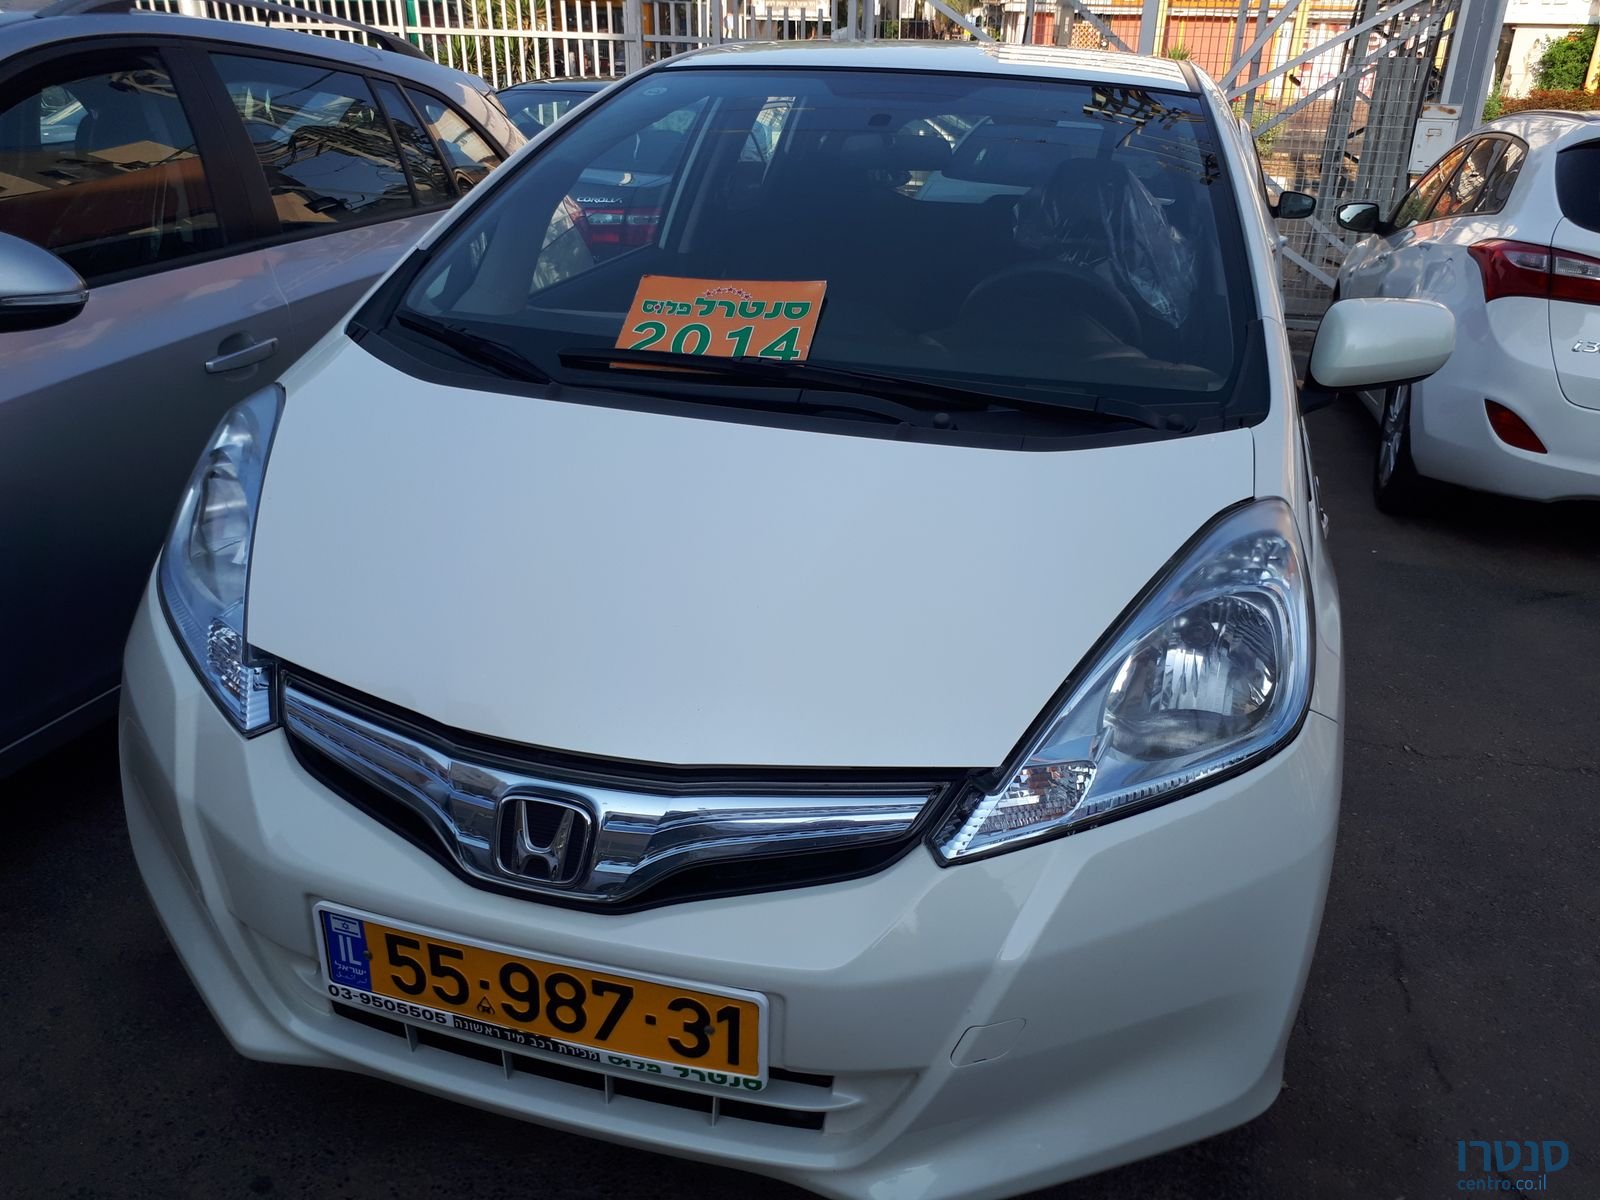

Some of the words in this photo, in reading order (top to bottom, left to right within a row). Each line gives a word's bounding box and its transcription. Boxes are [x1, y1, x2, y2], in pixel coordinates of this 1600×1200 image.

[695, 297, 812, 320] סנטרל
[628, 321, 802, 360] 2014
[1571, 340, 1600, 353] i3
[338, 935, 363, 966] IL
[328, 985, 448, 1024] 03-9505505
[454, 1018, 501, 1038] ראשונה
[504, 1030, 525, 1044] מיד
[530, 1037, 553, 1050] רכב
[558, 1043, 598, 1061] מכירת
[673, 1066, 763, 1091] סנטרל
